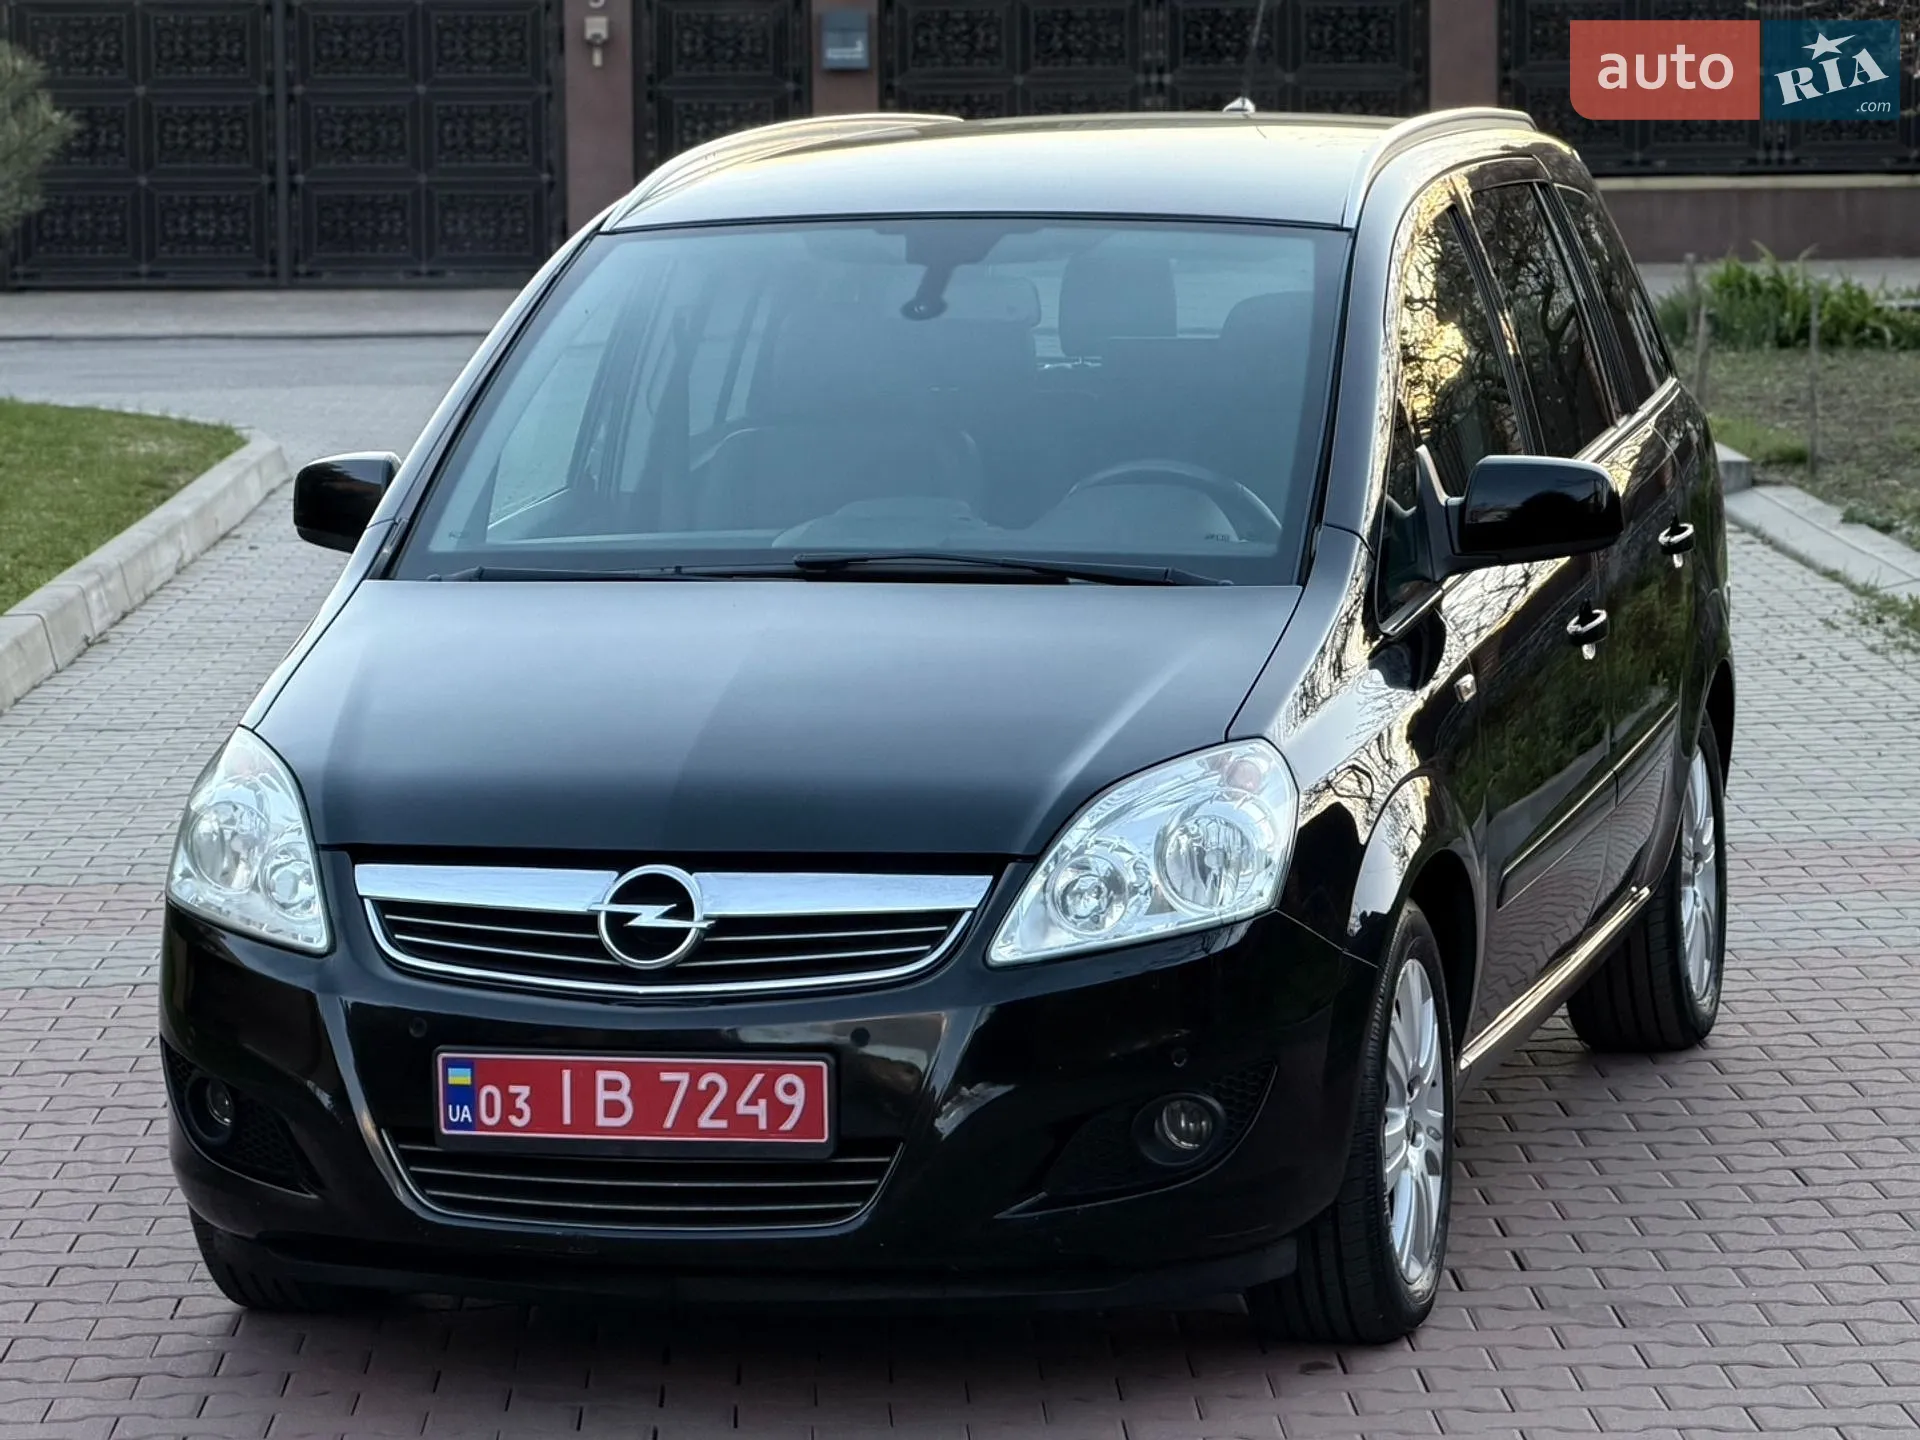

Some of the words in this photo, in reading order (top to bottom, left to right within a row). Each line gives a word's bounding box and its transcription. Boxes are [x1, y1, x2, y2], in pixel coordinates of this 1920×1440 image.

[448, 1104, 473, 1123] UA
[478, 1084, 532, 1128] 03
[659, 1071, 806, 1131] 7249
